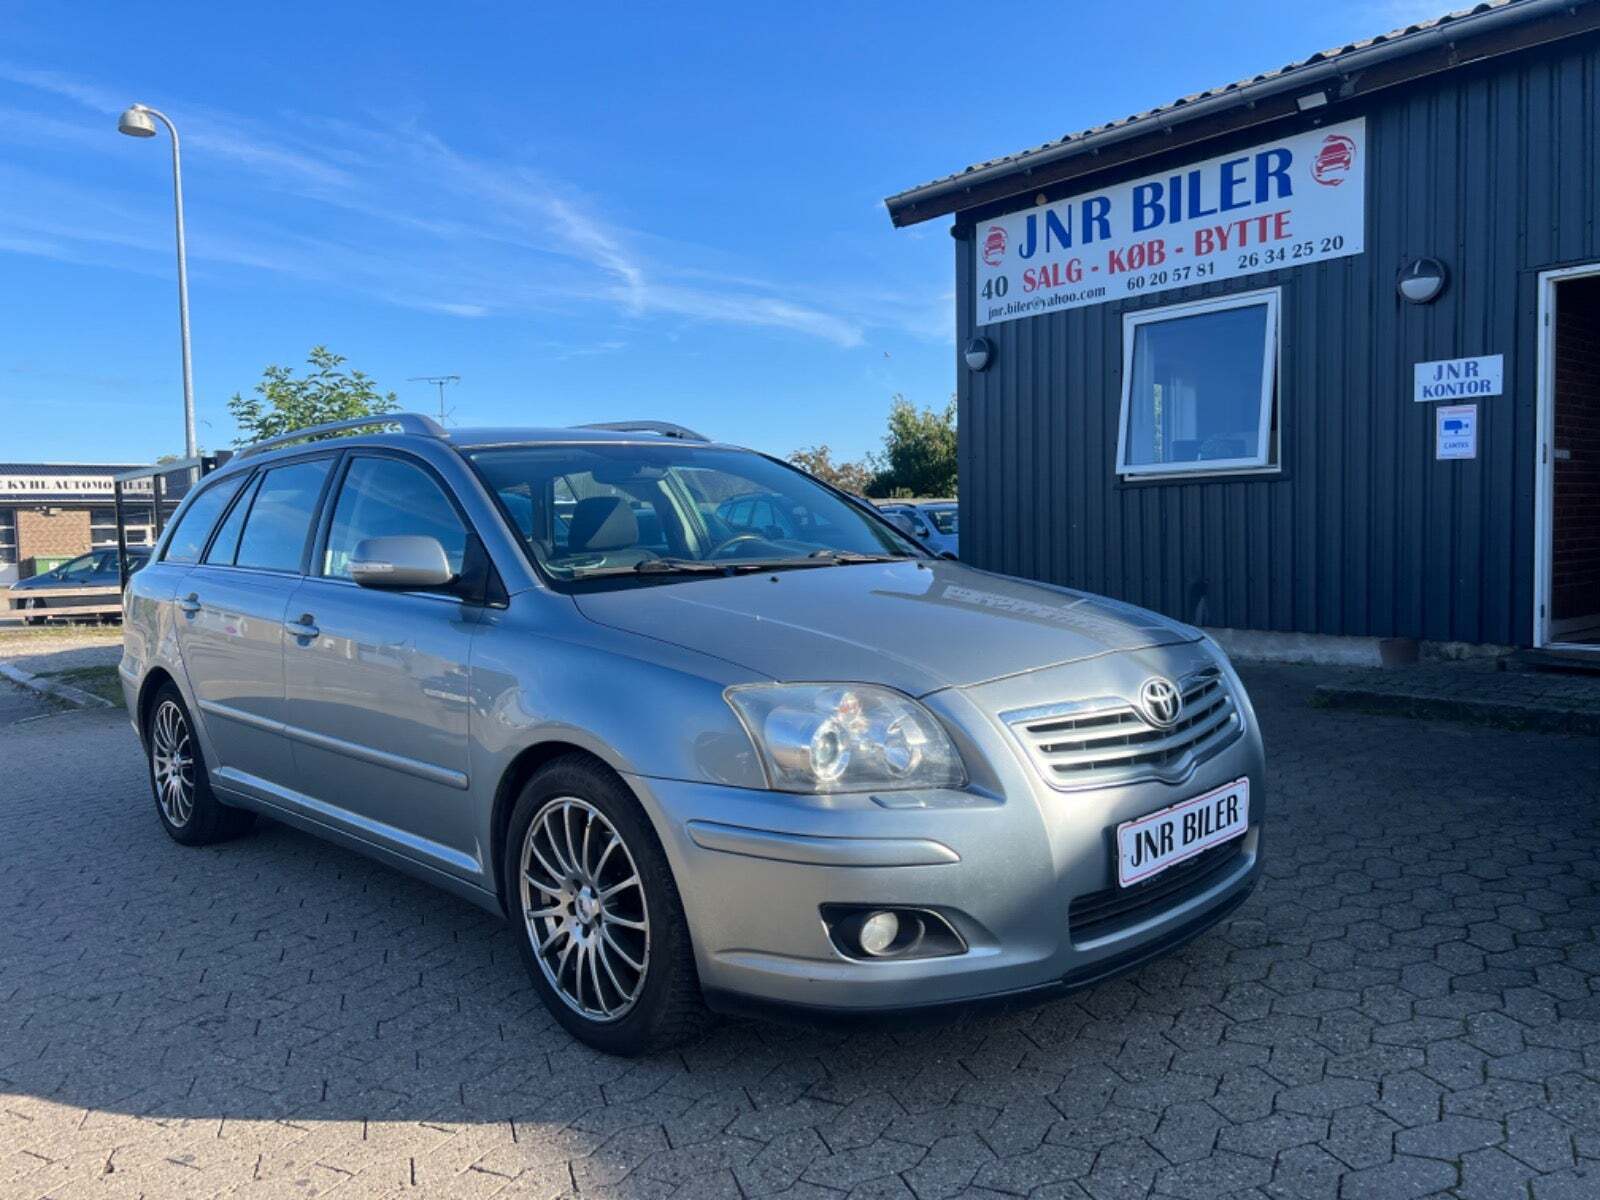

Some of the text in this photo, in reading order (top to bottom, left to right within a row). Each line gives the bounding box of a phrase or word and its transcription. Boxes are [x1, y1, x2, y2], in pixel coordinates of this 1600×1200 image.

[1018, 148, 1294, 260] JNR BILER
[1022, 258, 1083, 293] SALG
[1108, 239, 1166, 275] KØB
[1194, 209, 1293, 257] BYTTE
[1238, 235, 1345, 269] 26 34 25 20
[981, 275, 1009, 300] 40
[1126, 261, 1215, 291] 60 20 57 81
[987, 286, 1107, 320] jnr.biler@yahoo.com
[1432, 360, 1479, 382] JNR
[1422, 378, 1492, 399] KONTOR
[7, 479, 50, 490] KYHL
[1130, 793, 1239, 868] JNR BILER
